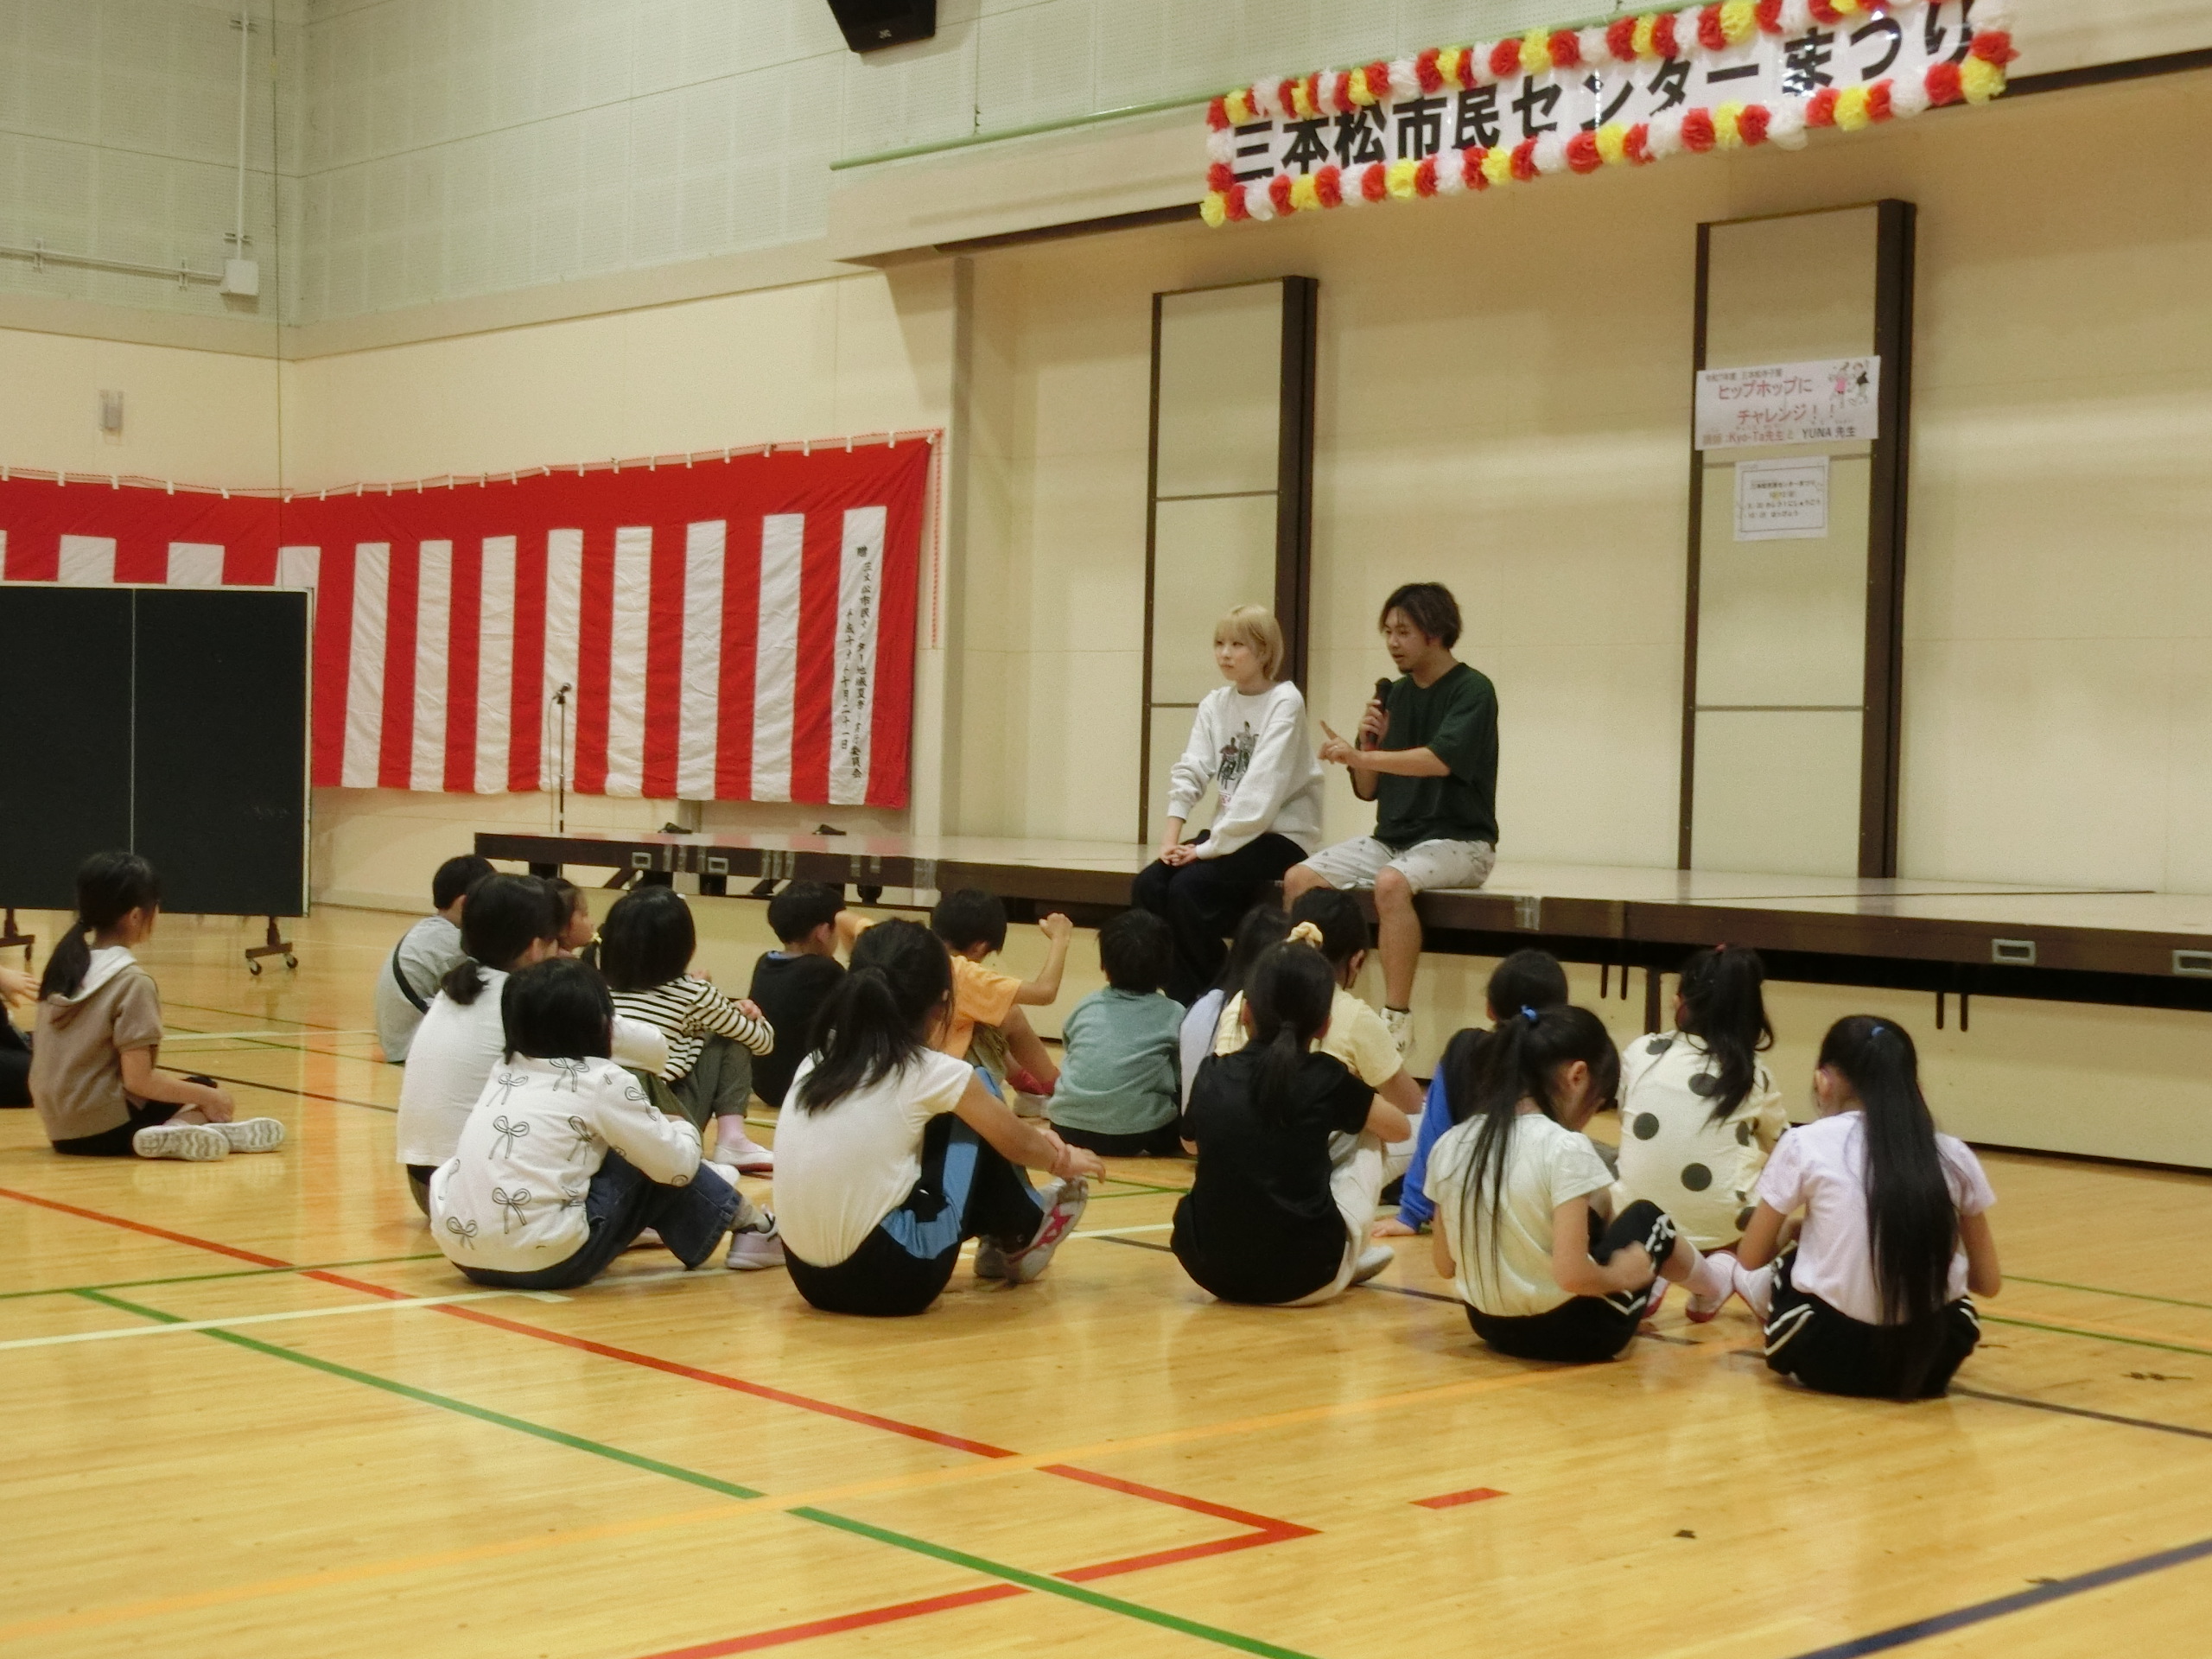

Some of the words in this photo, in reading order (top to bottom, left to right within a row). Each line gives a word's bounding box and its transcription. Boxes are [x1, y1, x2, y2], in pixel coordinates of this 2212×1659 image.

[1233, 0, 1974, 181] 三本松市民センターまつり
[1718, 378, 1813, 400] ヒップホップに
